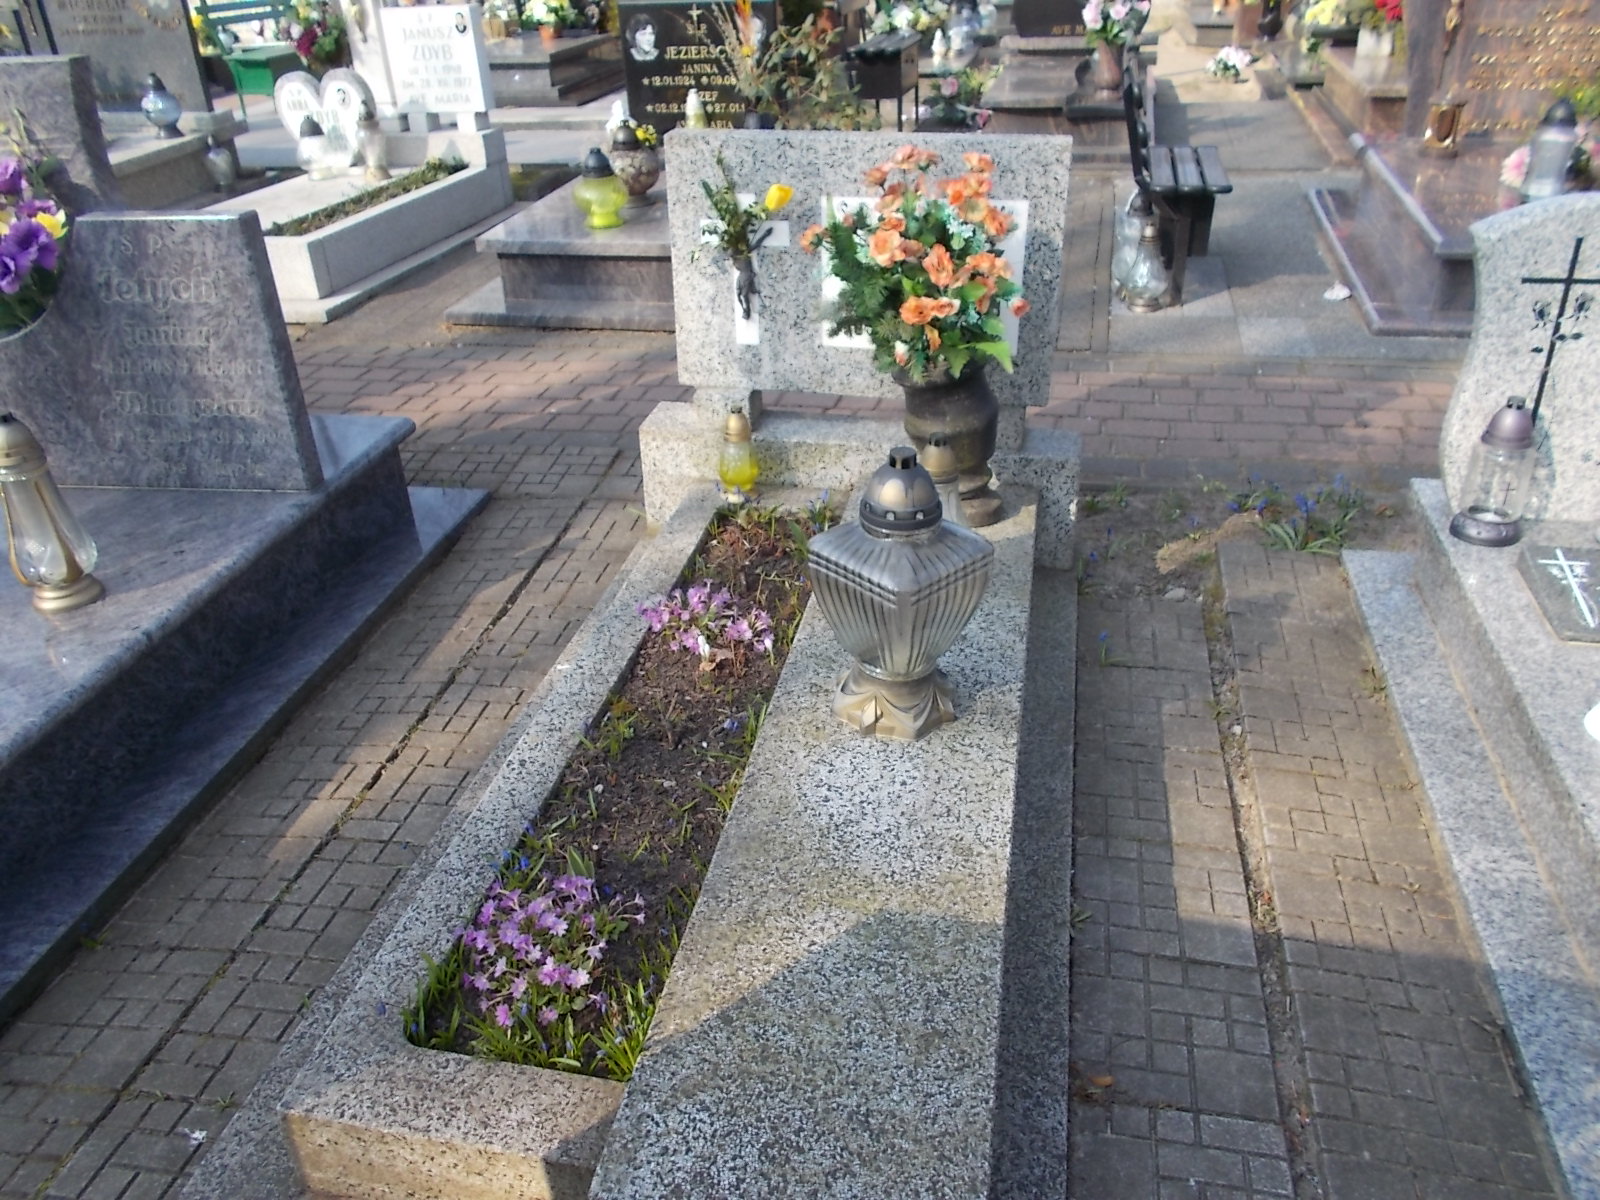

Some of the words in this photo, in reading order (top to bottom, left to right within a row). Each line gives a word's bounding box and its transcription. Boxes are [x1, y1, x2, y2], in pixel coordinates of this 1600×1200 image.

[411, 43, 453, 61] ZDYB
[664, 45, 728, 60] JEZIERSC
[681, 63, 718, 74] JANINA
